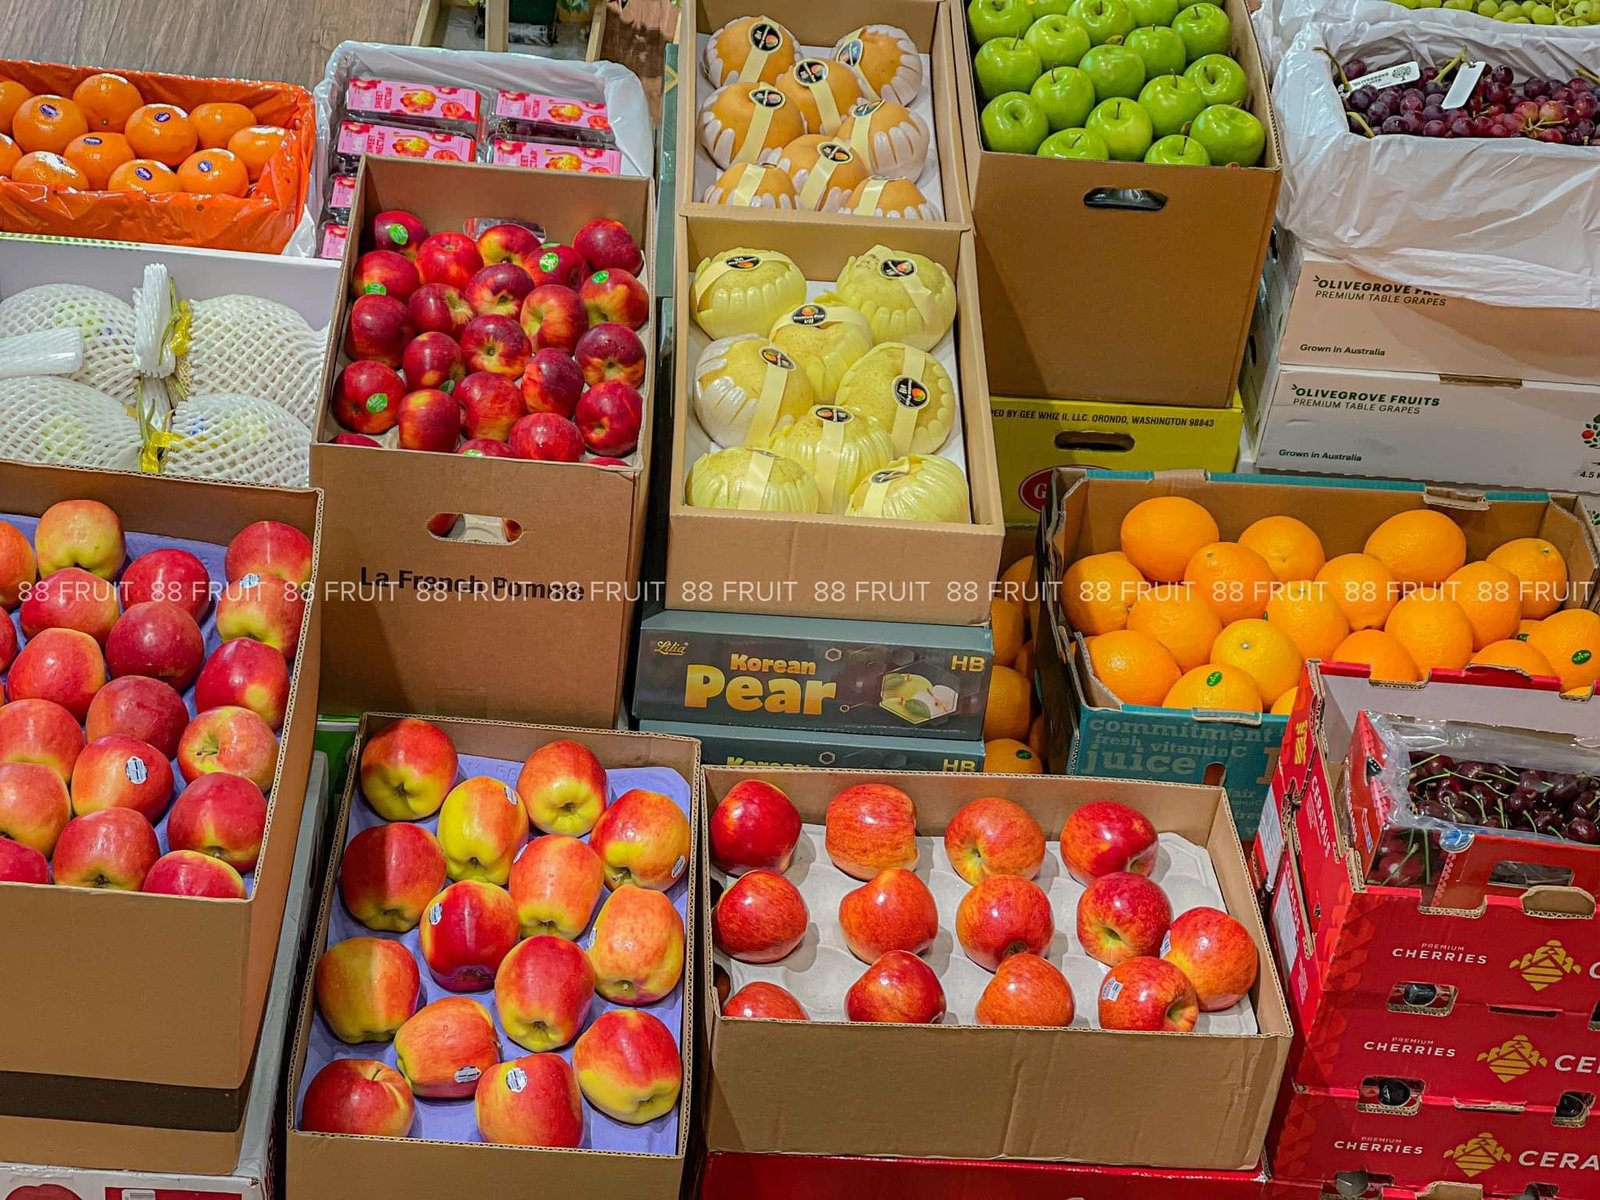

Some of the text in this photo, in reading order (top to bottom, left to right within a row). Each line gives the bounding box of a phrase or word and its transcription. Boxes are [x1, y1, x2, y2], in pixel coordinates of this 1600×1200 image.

[1318, 279, 1411, 294] OLIVEGROVE
[1315, 290, 1446, 307] PREMIUM TABLE GRAPES
[1300, 343, 1385, 356] Grown in Australia
[1296, 387, 1441, 407] OLIVEGROVE FRUITS
[1293, 398, 1421, 415] PREMIUM TABLE GRAPES
[1007, 409, 1018, 418] BY
[1020, 410, 1036, 419] GEE
[1038, 411, 1060, 421] WHIZ
[1092, 413, 1129, 425] ORONDO,
[1132, 415, 1187, 426] WASHINGTON
[1189, 418, 1215, 427] 98843
[1279, 448, 1362, 462] Grown in Australia
[360, 567, 585, 601] La French Pomme
[730, 653, 816, 675] Korean
[951, 655, 985, 672] HB
[683, 664, 837, 716] Pear
[1089, 719, 1273, 743] commitment
[1095, 733, 1141, 747] fresh
[1082, 743, 1197, 775] juice
[1311, 776, 1331, 858] CERASUS
[1421, 943, 1465, 951] PREMIUM
[1392, 948, 1488, 965] CHERRIES
[1363, 1041, 1456, 1057] CHERRIES
[1391, 1036, 1434, 1045] PREMIUM
[1554, 1055, 1600, 1074] CE
[1334, 1140, 1423, 1155] CHERRIES
[1361, 1136, 1402, 1144] PREMIUM
